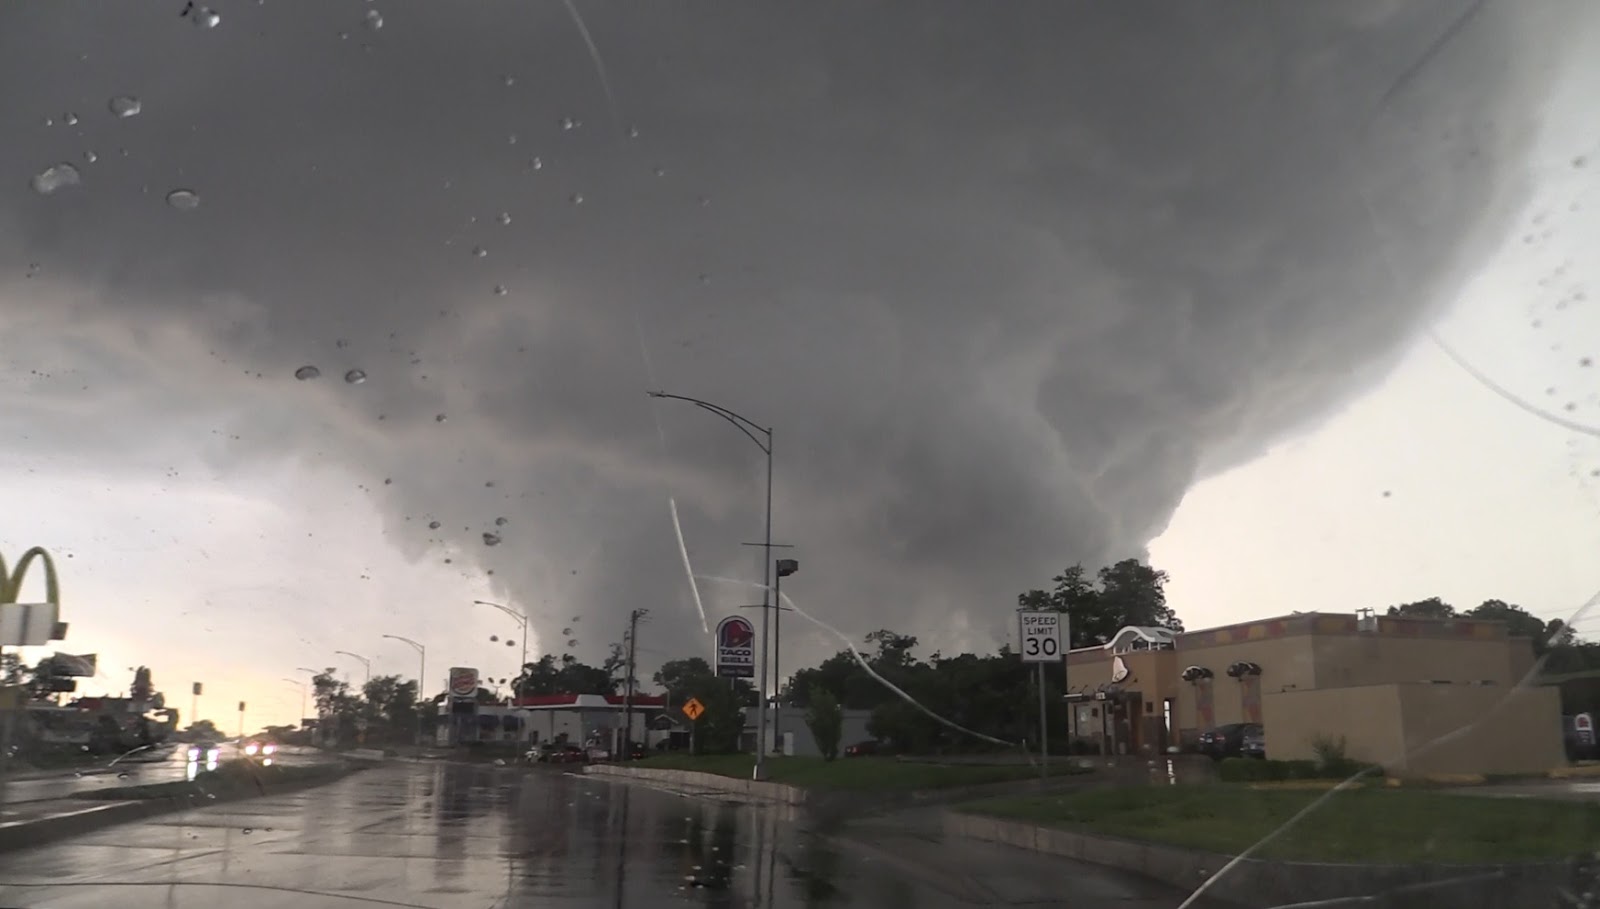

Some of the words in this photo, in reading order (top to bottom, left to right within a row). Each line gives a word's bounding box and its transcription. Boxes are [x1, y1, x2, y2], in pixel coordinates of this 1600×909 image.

[1023, 616, 1057, 626] SPEED
[1027, 627, 1054, 635] LIMIT
[1026, 637, 1057, 656] 30
[720, 648, 751, 656] TACO
[721, 656, 752, 664] BELL
